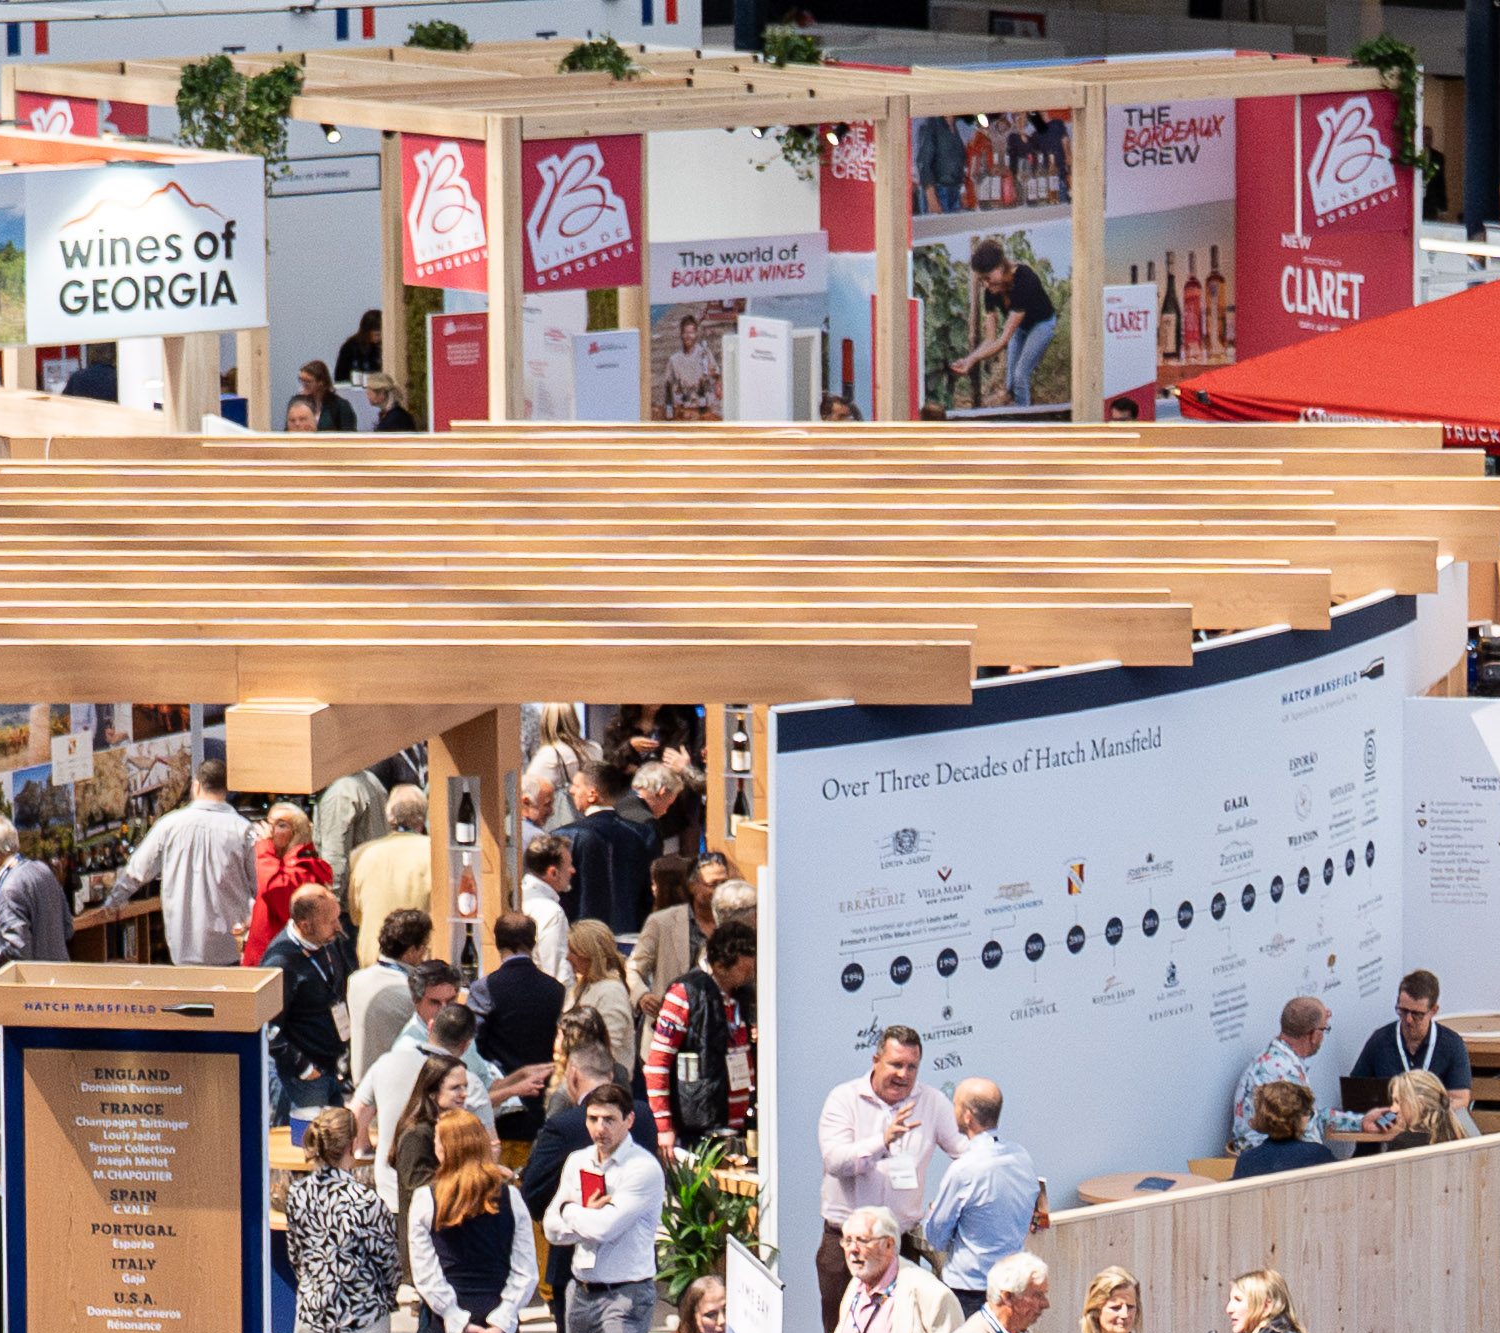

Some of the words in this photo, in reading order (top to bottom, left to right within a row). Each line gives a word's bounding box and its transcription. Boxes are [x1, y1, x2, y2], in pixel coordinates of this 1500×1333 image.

[1123, 106, 1171, 127] THE
[1122, 114, 1226, 152] BORDEAUX
[1123, 144, 1201, 167] CREW
[60, 229, 182, 268] wines
[194, 219, 237, 262] of
[1281, 233, 1313, 250] NEW
[537, 242, 635, 286] BORDEAUX
[678, 252, 714, 268] The
[719, 246, 773, 265] world
[777, 243, 798, 260] of
[670, 265, 755, 289] BORDEAUX
[758, 262, 806, 282] WINES
[60, 269, 238, 315] GEORGIA
[1280, 263, 1365, 321] CLARET
[822, 777, 870, 802] Over
[875, 769, 930, 794] Three
[936, 757, 1007, 786] Decades
[1012, 751, 1033, 775] of
[1034, 742, 1086, 771] Hatch
[1090, 726, 1162, 761] Mansfield
[24, 1002, 71, 1012] HATCH
[74, 1003, 157, 1015] MANSFIELD
[94, 1068, 171, 1082] ENGLAND
[100, 1102, 165, 1116] FRANCE
[75, 1116, 138, 1131] Champagne
[109, 1189, 158, 1203] SPAIN
[91, 1222, 177, 1237] PORTUGAL
[111, 1257, 157, 1271] ITALY
